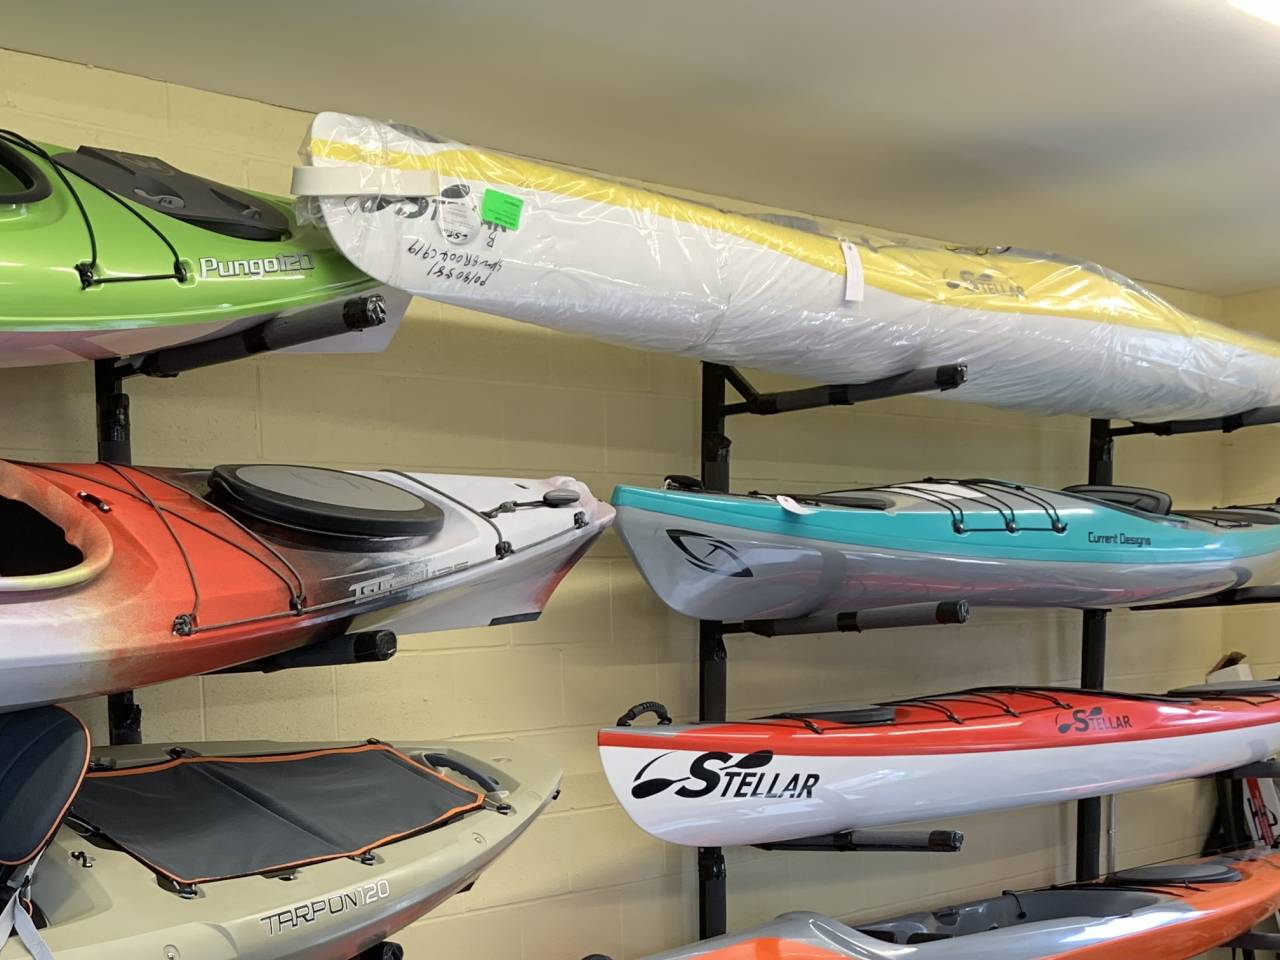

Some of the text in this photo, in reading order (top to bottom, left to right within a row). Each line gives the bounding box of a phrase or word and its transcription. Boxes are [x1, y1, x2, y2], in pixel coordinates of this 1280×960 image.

[1088, 531, 1151, 548] Current Designs
[1073, 709, 1132, 732] STELLAR
[675, 751, 820, 799] STELLAR
